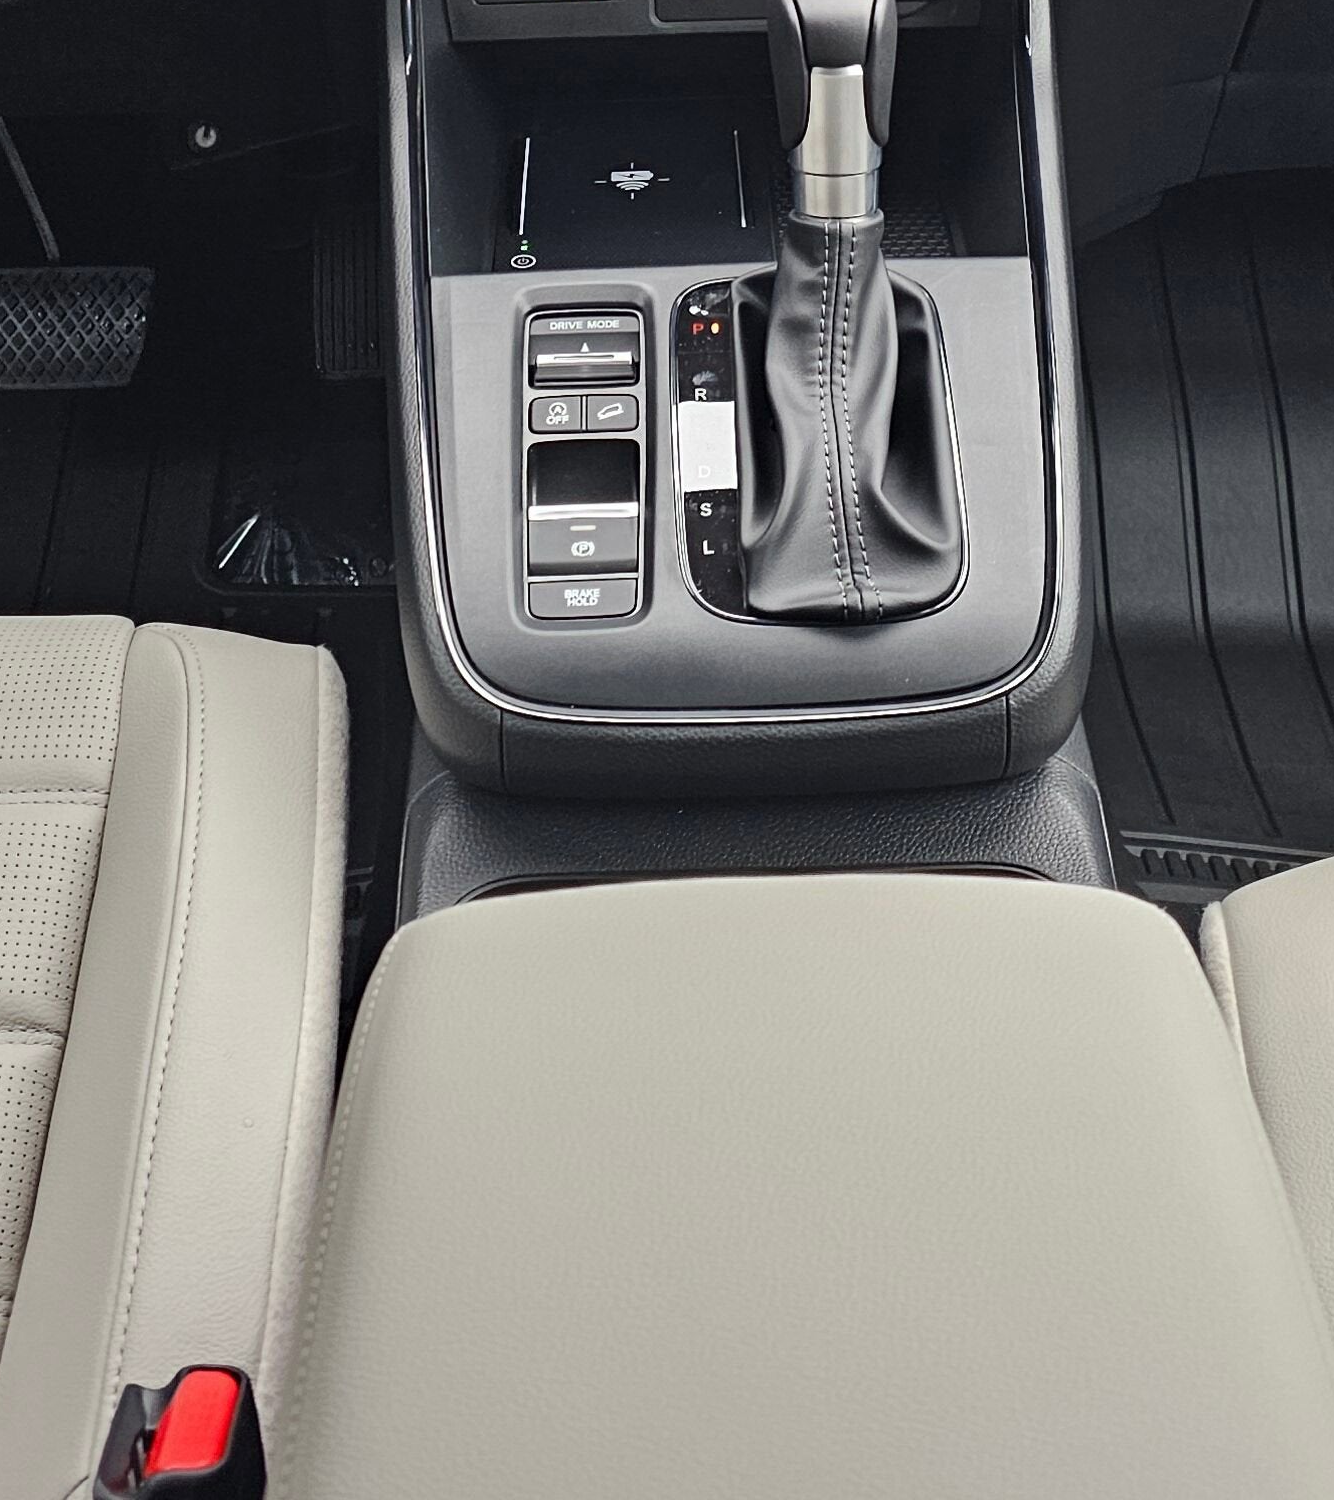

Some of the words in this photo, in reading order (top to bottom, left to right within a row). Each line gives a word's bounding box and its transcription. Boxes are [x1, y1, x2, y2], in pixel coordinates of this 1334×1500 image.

[550, 321, 583, 330] DRIVE
[587, 319, 620, 329] MODE
[692, 323, 704, 335] P
[694, 387, 707, 401] R
[546, 415, 569, 425] OFF
[698, 465, 711, 478] D
[700, 502, 713, 517] S
[702, 539, 715, 555] L
[564, 588, 601, 598] BRAKE
[567, 597, 598, 607] HOLD
